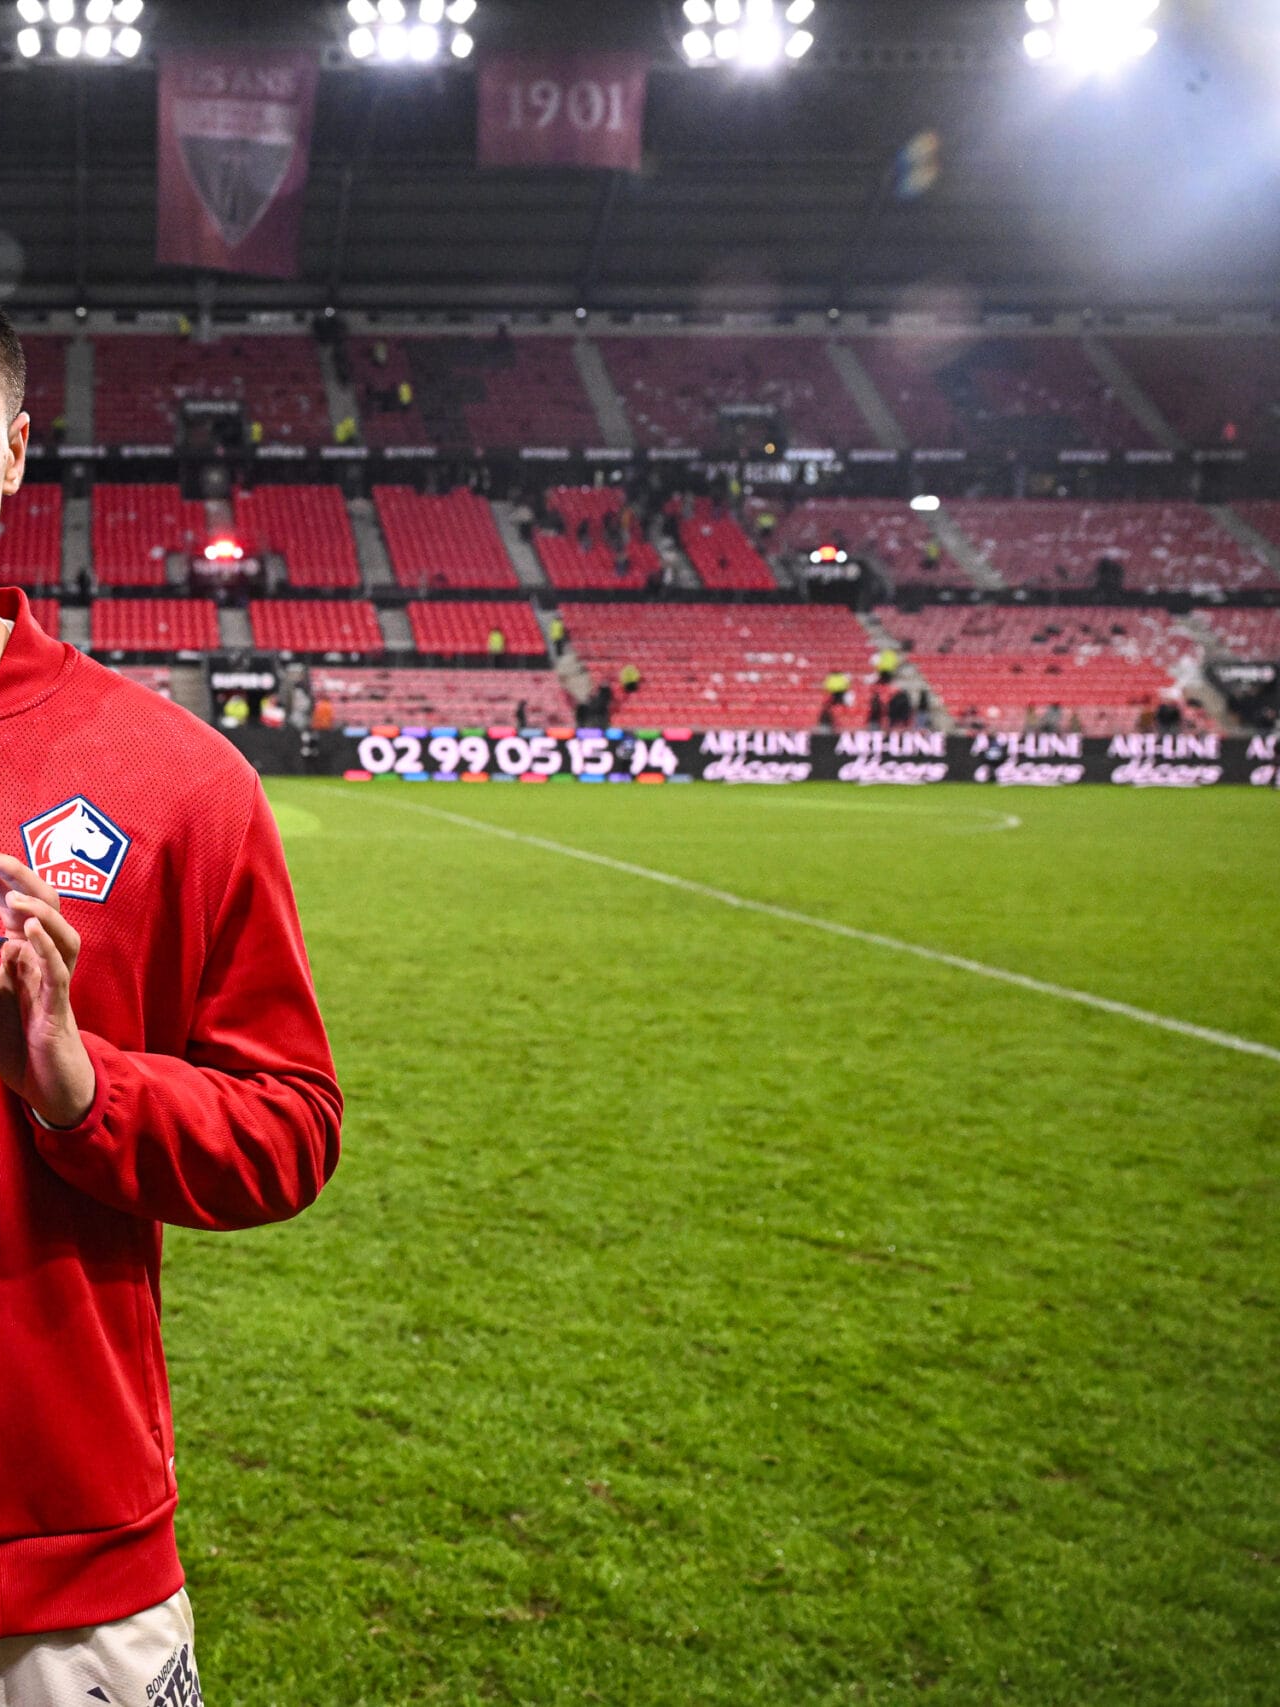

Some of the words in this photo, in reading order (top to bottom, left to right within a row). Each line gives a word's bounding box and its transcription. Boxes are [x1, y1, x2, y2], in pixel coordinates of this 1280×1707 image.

[506, 80, 623, 131] 1901
[358, 735, 423, 773] 02
[428, 736, 489, 774] 99
[494, 736, 562, 774] 05
[566, 737, 614, 775] 15
[700, 730, 811, 756] ART-LINE
[835, 731, 946, 757] ART-LINE
[1107, 733, 1220, 760] ART-LINE
[45, 869, 99, 891] LOSC
